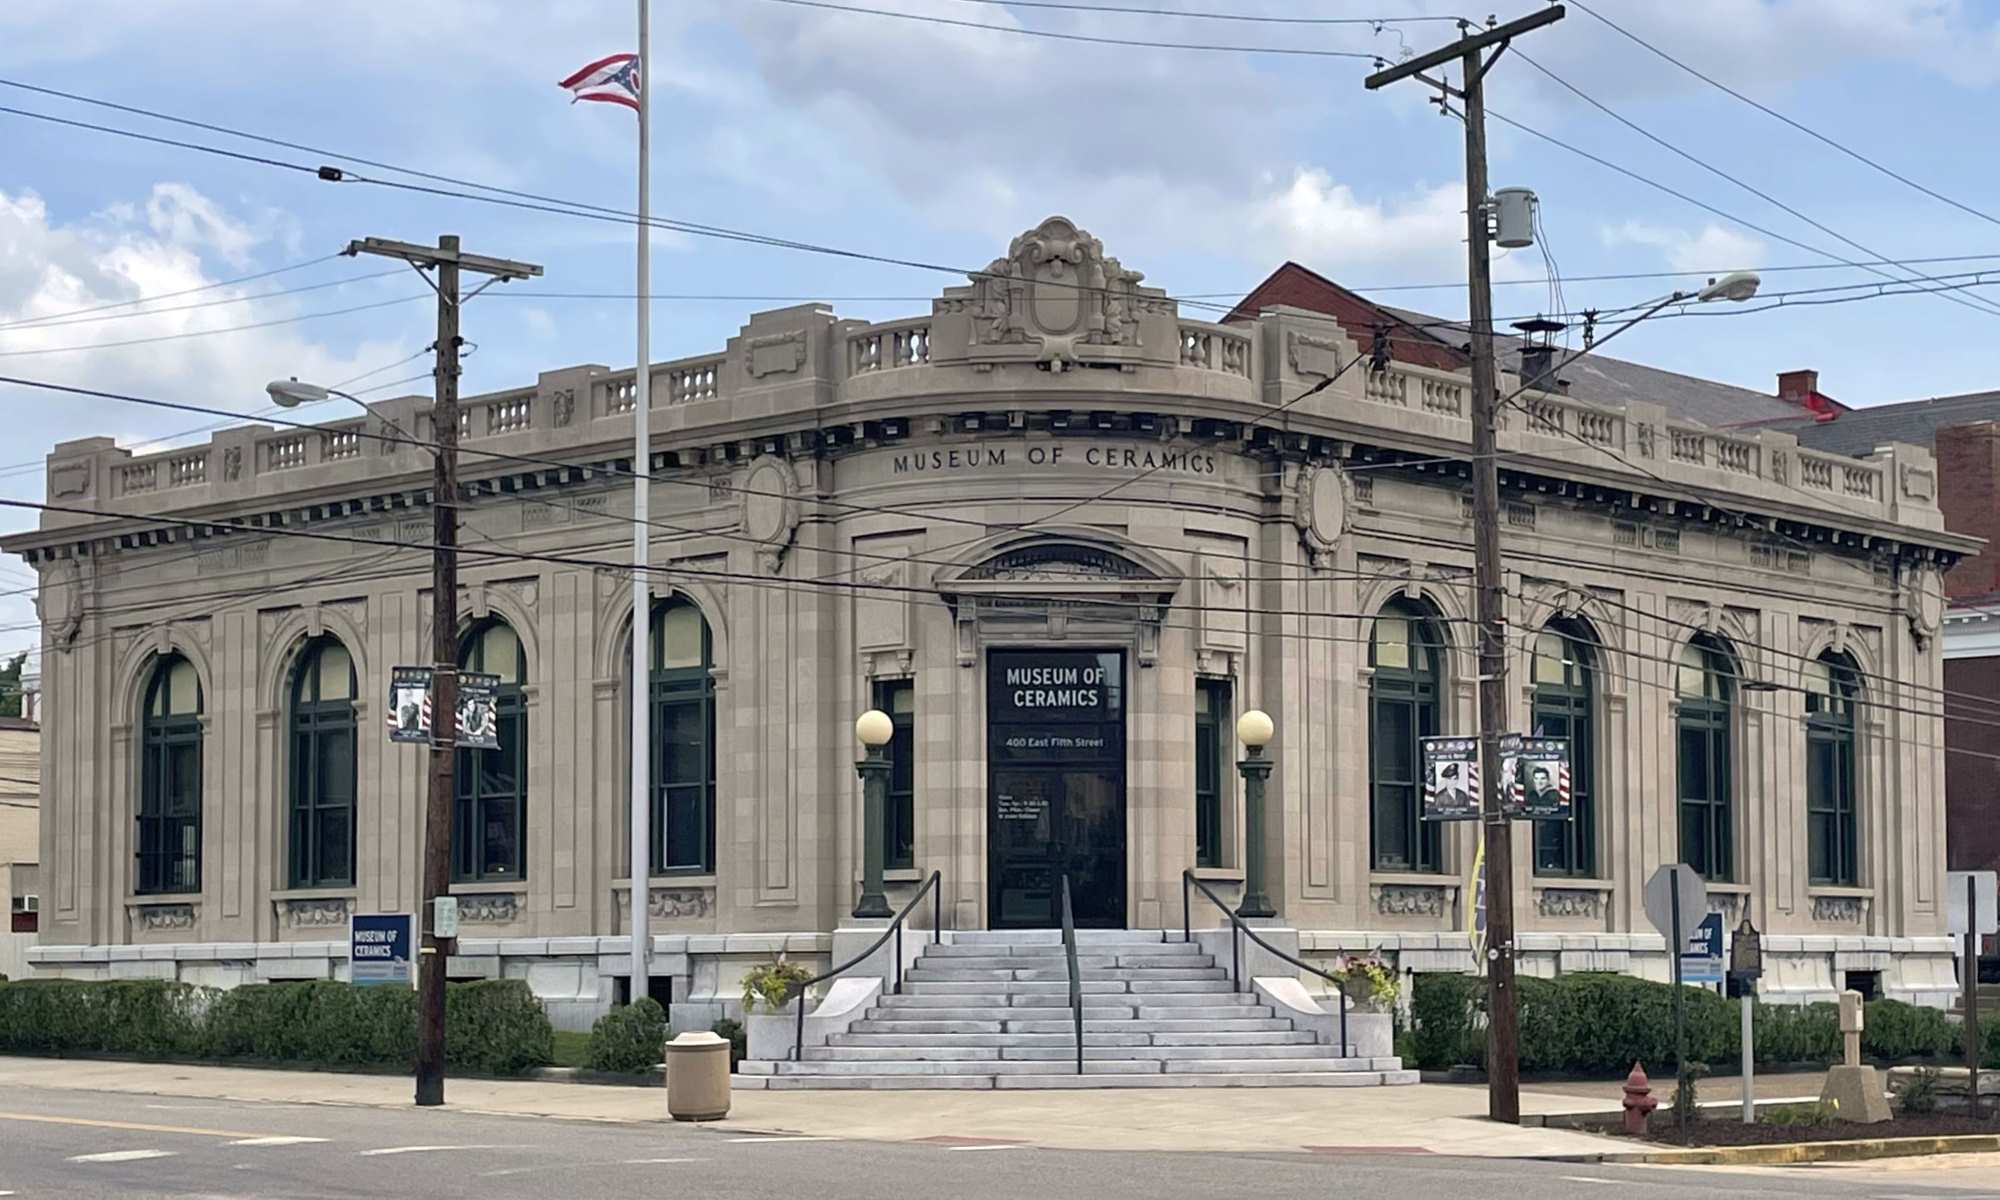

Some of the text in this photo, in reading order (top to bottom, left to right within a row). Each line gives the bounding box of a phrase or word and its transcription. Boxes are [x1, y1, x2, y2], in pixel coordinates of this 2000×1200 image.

[893, 447, 1215, 475] MUSEUM OF CERAMICS
[1007, 667, 1104, 686] MUSEUM OF
[1014, 689, 1098, 708] CERAMICS
[1006, 737, 1103, 748] 400 East Fifth Street
[354, 930, 398, 943] MUSEUM OF
[354, 945, 391, 957] CERAMICS
